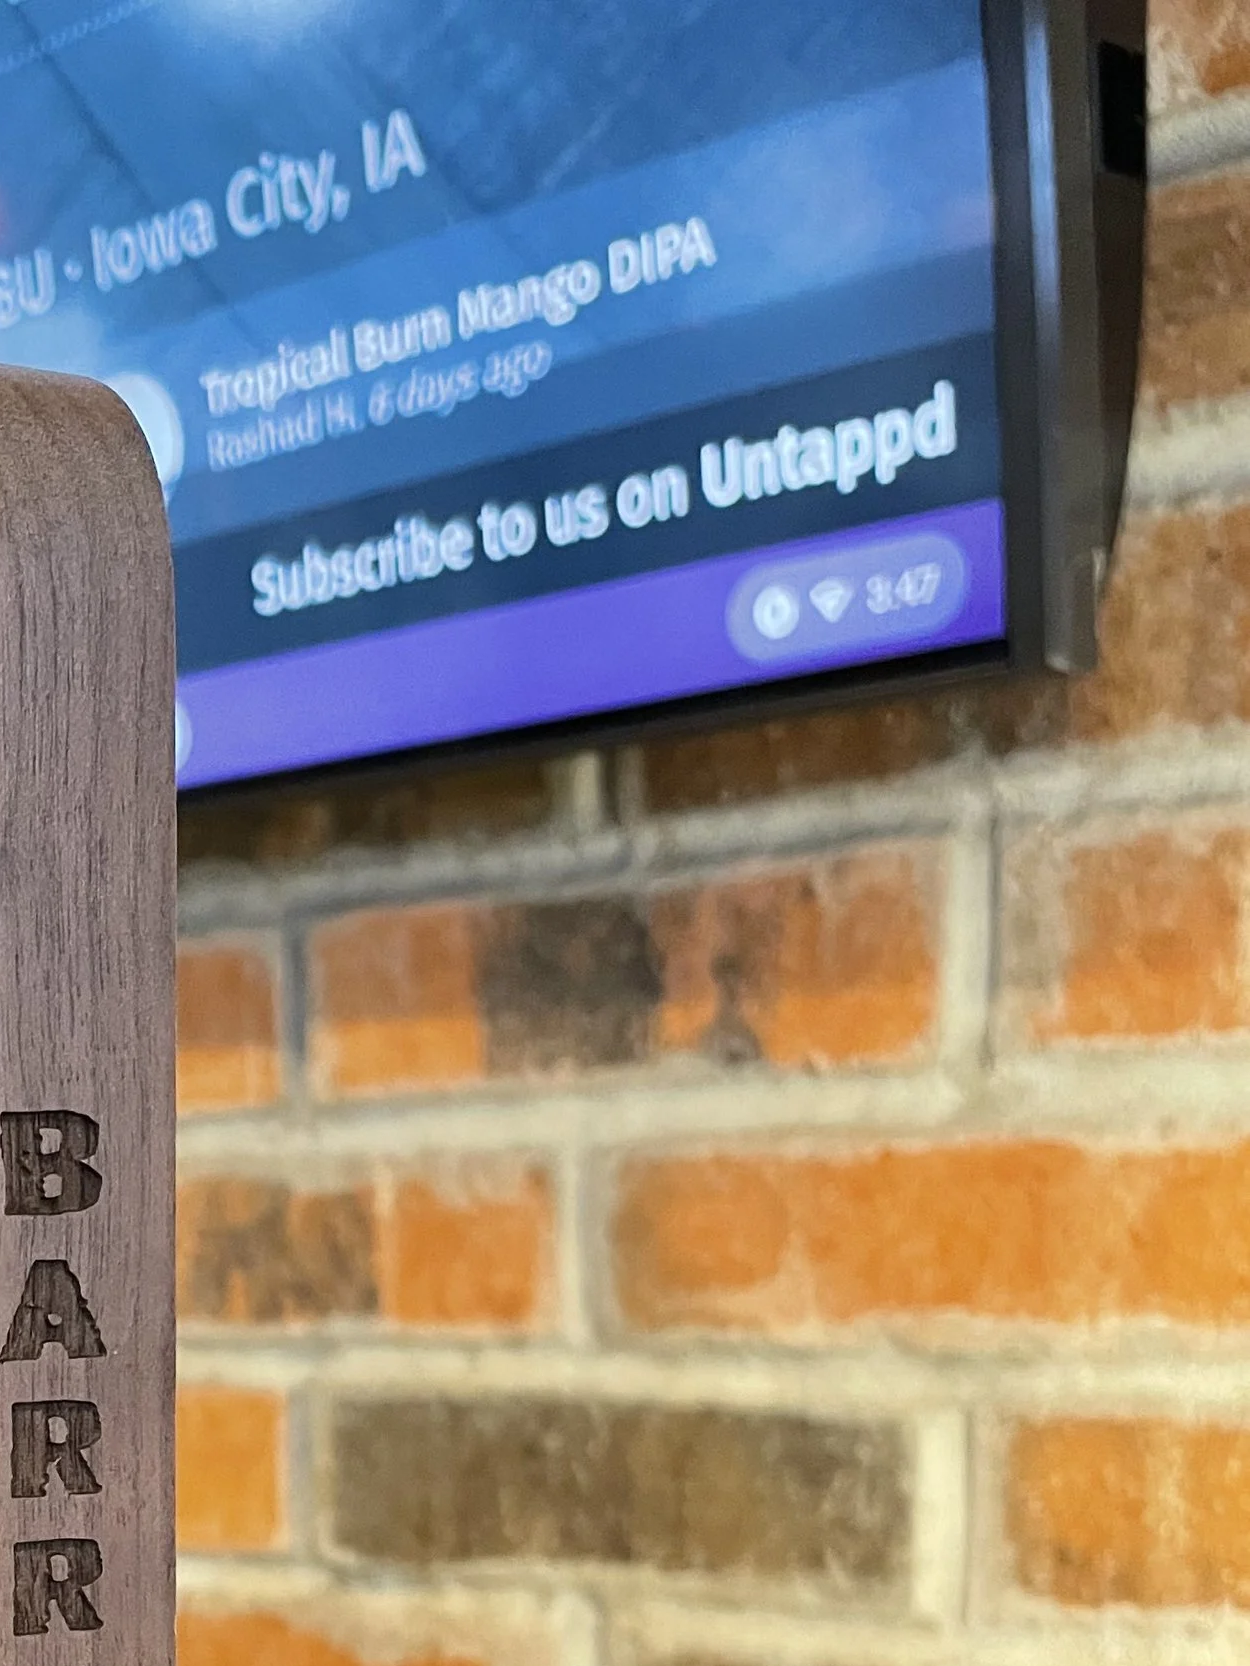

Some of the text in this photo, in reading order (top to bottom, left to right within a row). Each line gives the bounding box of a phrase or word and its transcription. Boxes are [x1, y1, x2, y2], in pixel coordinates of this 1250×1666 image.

[90, 198, 217, 292] Iowa
[225, 146, 350, 238] City,
[361, 108, 427, 194] IA
[200, 215, 719, 416] Tropical Burn Mango DIPA
[396, 358, 481, 418] days
[482, 338, 553, 398] ago
[251, 378, 958, 617] Subscribe to us on Untappd
